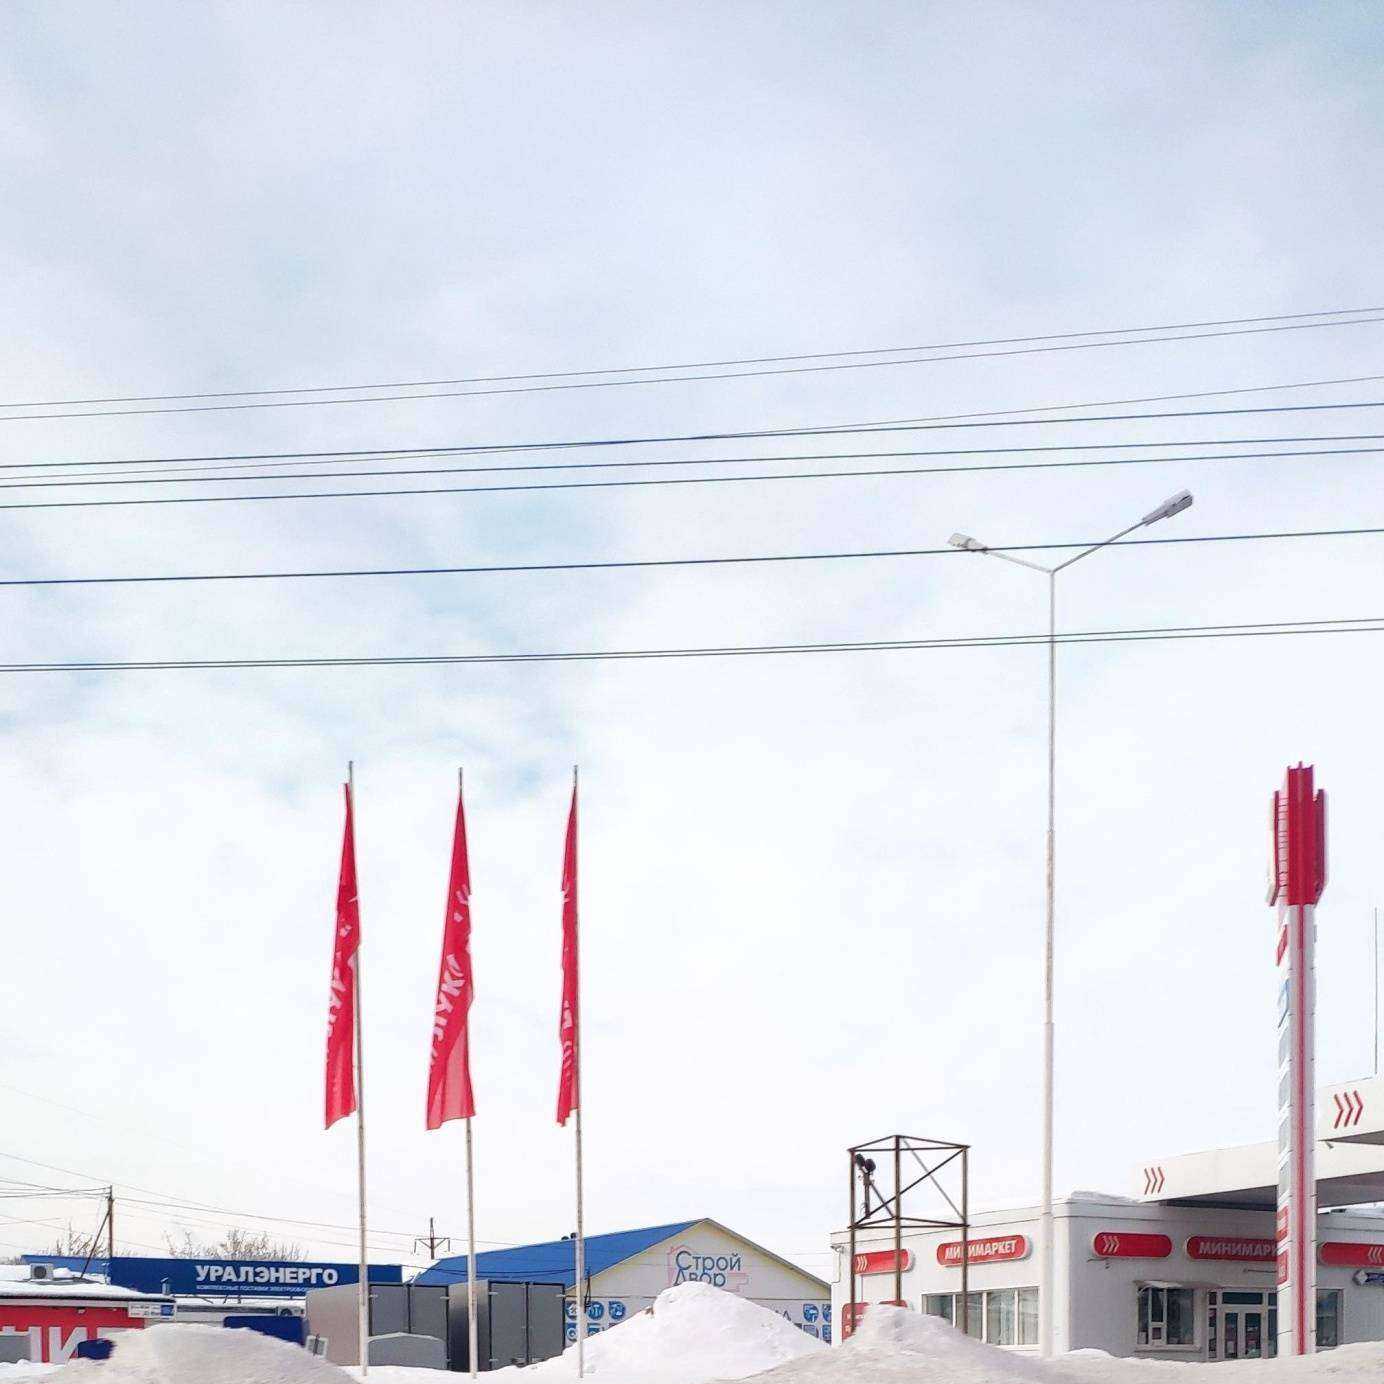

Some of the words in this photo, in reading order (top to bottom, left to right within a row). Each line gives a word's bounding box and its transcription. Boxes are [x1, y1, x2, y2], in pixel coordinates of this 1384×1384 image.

[945, 1240, 1017, 1260] МИИМАРКЕТ
[1199, 1242, 1278, 1257] МИНИМАРК
[675, 1250, 741, 1271] Строй
[195, 1264, 338, 1284] УРАЛЭНЕРГО
